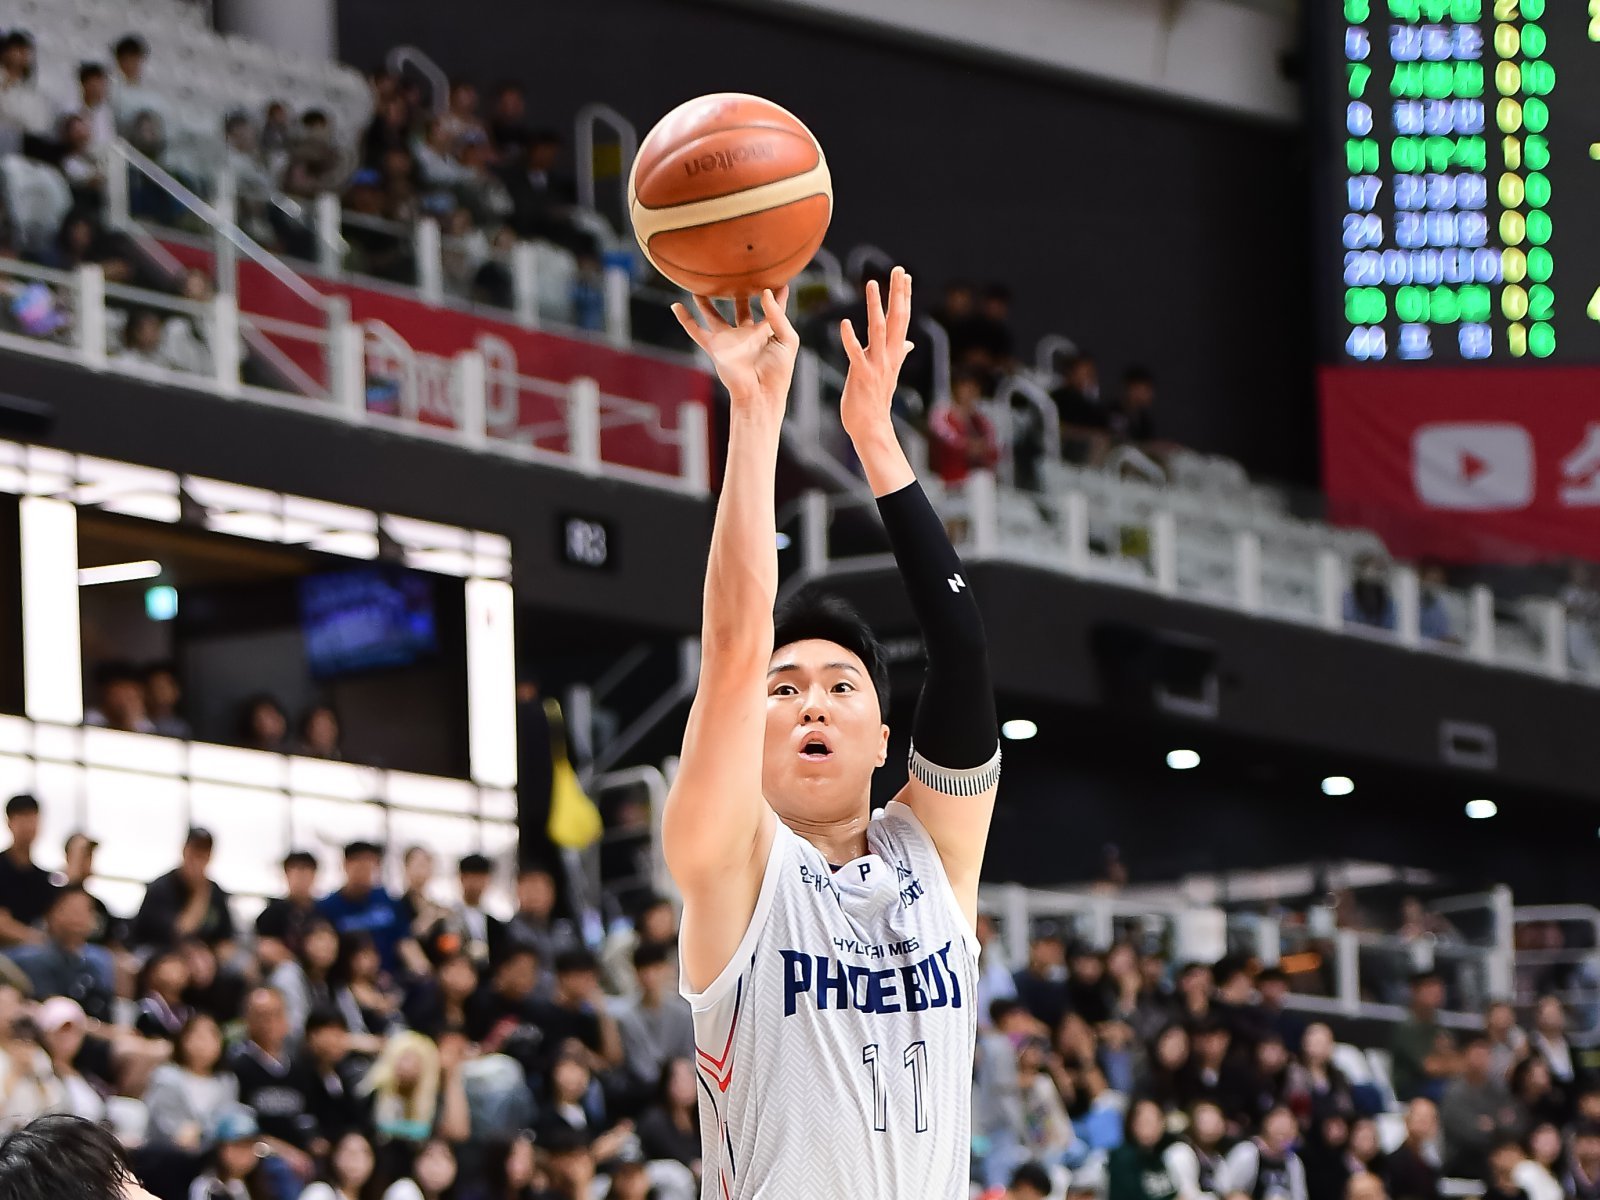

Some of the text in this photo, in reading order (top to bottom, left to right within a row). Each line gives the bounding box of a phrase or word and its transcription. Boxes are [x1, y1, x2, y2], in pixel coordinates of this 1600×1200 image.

[684, 143, 775, 177] molten
[857, 862, 871, 882] P
[863, 1041, 929, 1134] 11
